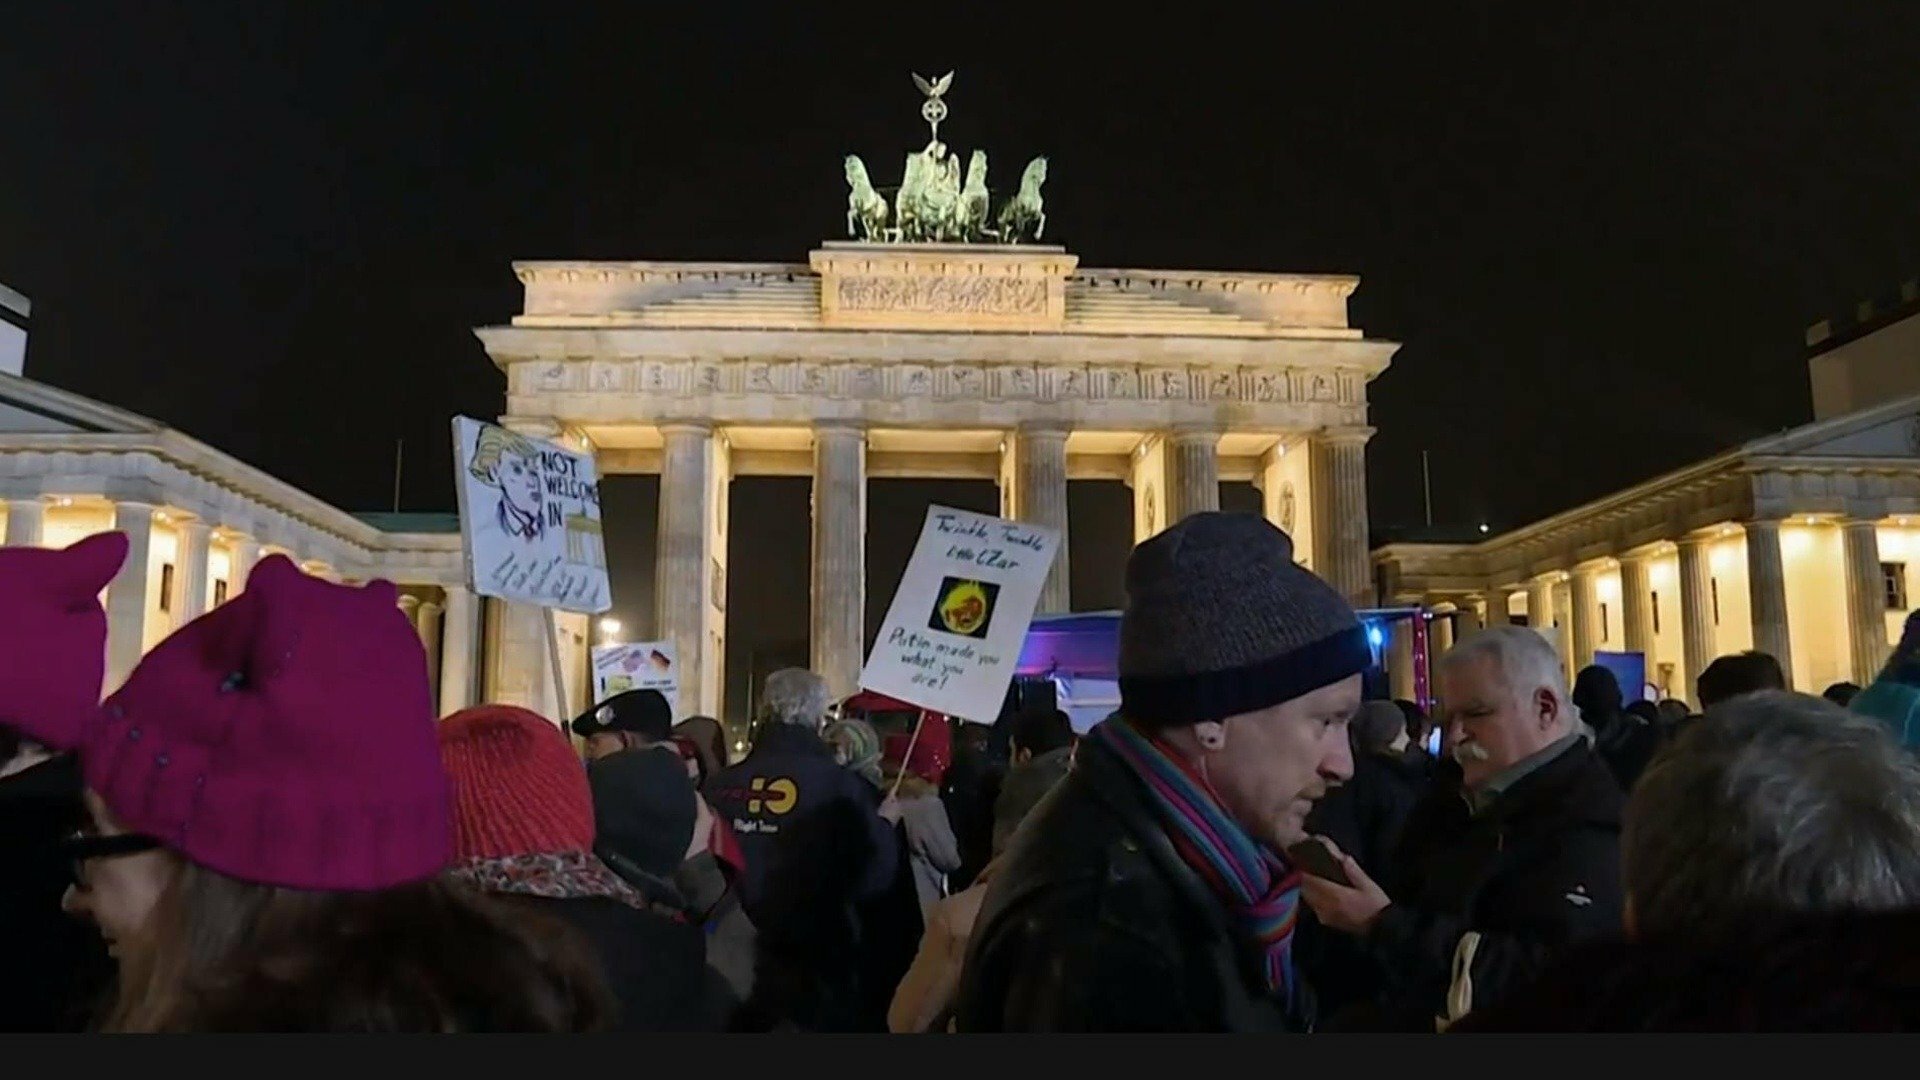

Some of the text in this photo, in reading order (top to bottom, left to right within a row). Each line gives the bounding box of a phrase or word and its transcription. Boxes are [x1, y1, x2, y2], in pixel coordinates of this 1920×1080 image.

[541, 450, 579, 477] NOT
[544, 475, 600, 505] WELCOME
[547, 501, 564, 527] IN
[888, 626, 1000, 667] Putin made you
[900, 652, 964, 677] what you
